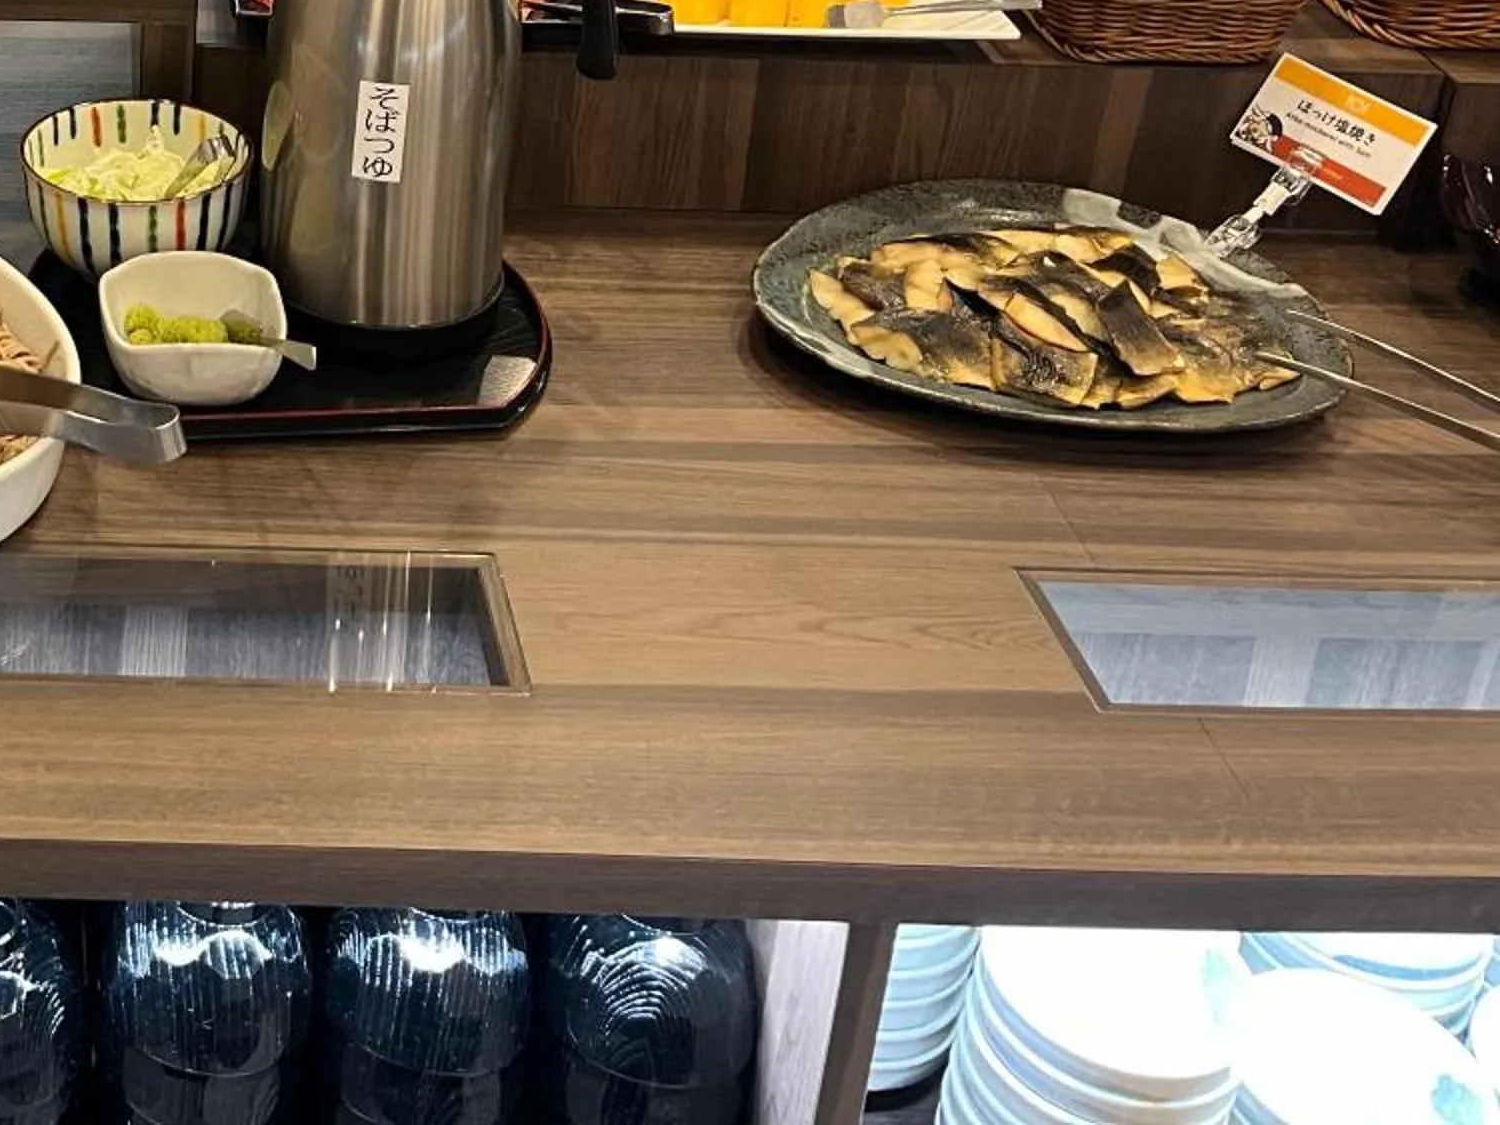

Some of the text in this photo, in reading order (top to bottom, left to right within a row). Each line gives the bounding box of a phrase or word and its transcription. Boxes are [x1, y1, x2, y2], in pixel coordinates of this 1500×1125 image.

[362, 86, 400, 177] そばつゆ
[1297, 99, 1377, 146] ほっけ塩焼き
